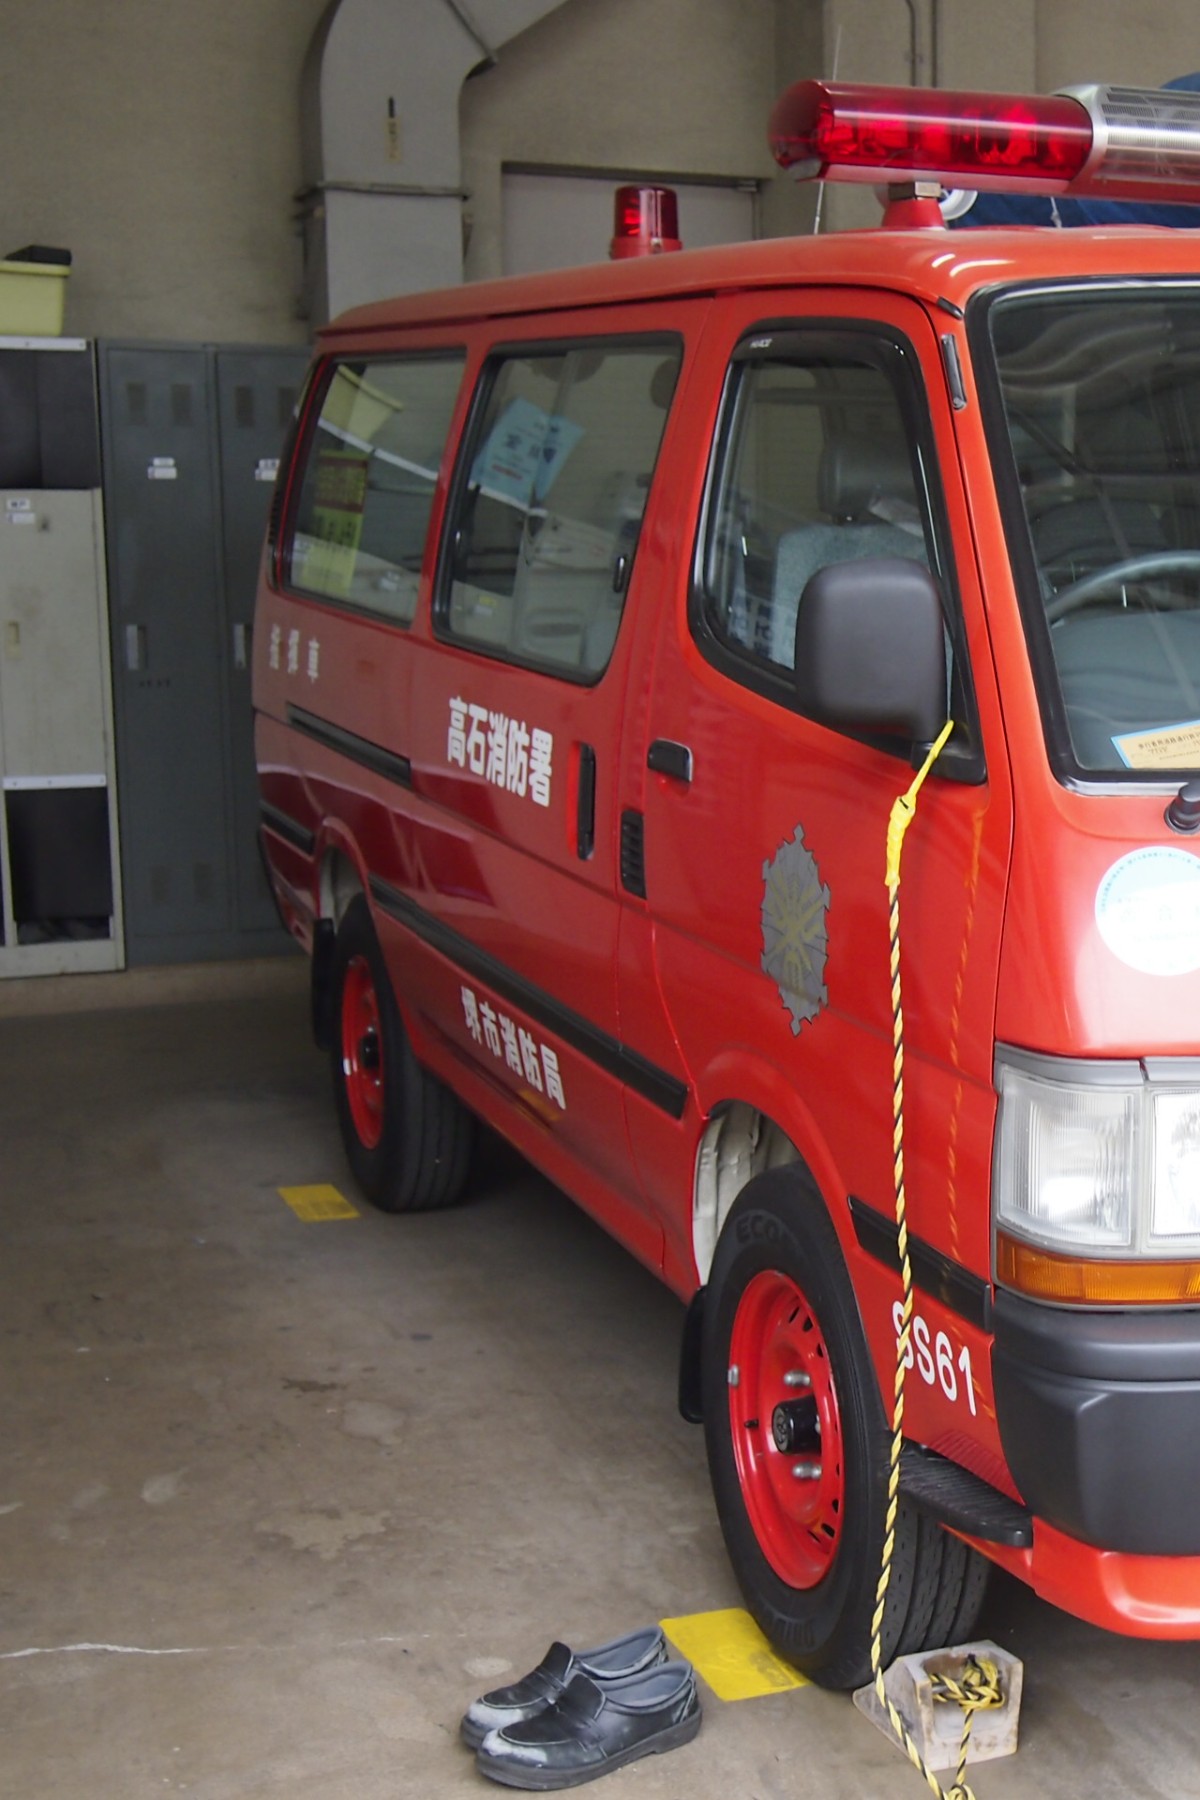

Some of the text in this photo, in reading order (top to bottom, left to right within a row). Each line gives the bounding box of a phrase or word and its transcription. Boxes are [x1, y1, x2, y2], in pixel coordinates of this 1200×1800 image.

[447, 695, 553, 808] 高石消防署
[460, 985, 567, 1111] 堺市消防局
[892, 1300, 977, 1417] SS61
